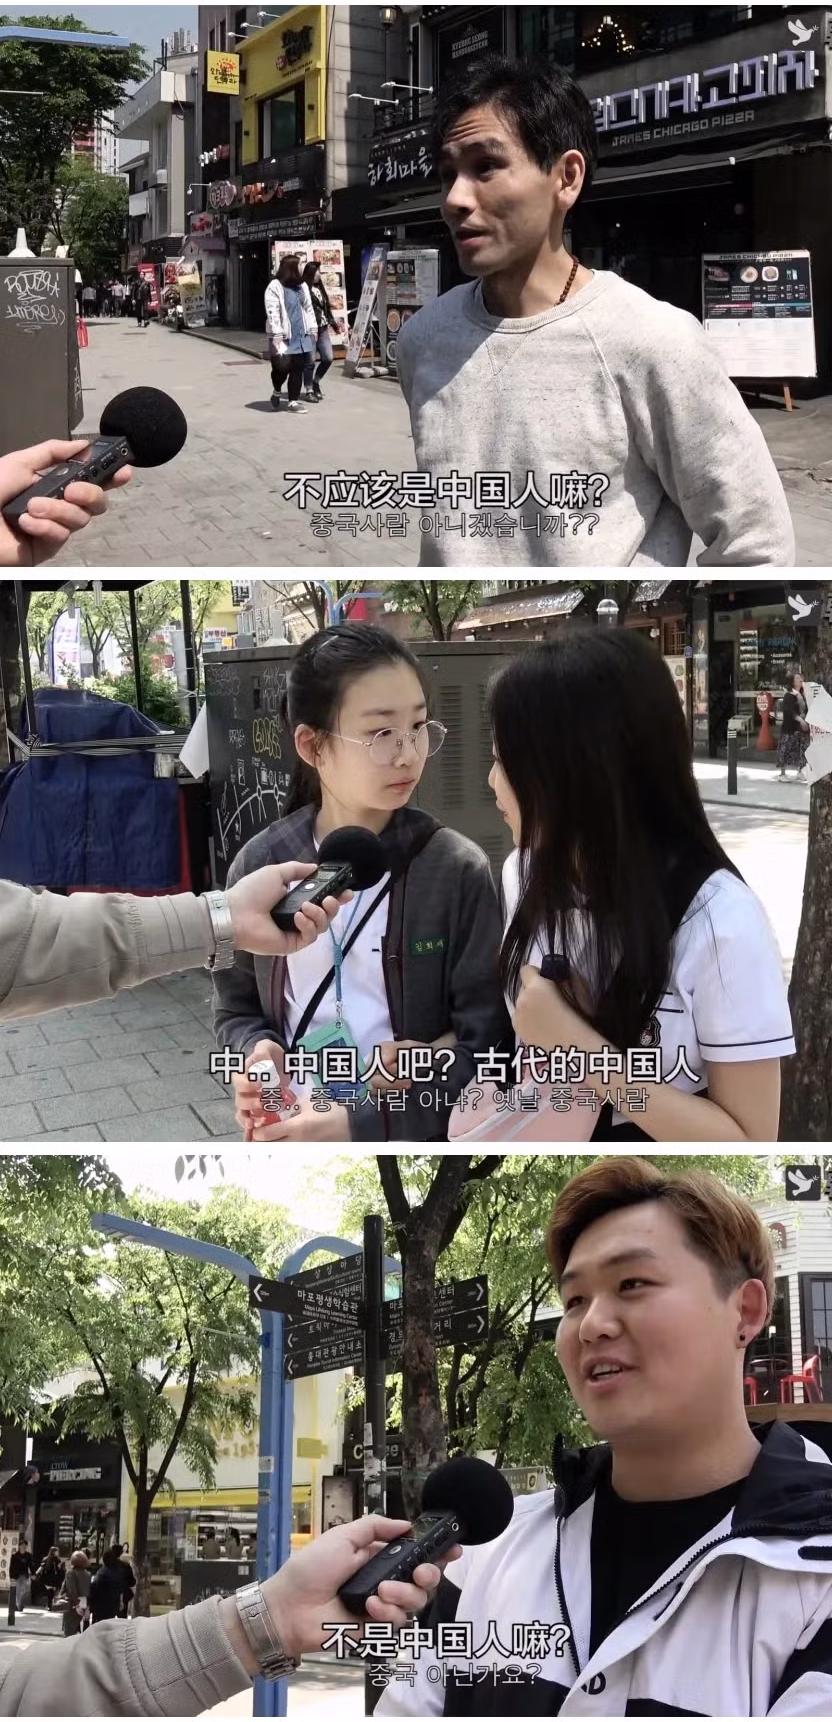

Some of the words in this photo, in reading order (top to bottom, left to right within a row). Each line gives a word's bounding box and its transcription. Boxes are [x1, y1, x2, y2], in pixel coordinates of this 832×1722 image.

[612, 130, 651, 146] JAMES
[653, 118, 709, 139] CHICAGO
[711, 109, 755, 128] PIZZA
[367, 145, 433, 187] 하회마을
[297, 1289, 358, 1314] 마포평생학습관
[308, 1340, 362, 1363] 홍대관광안내소
